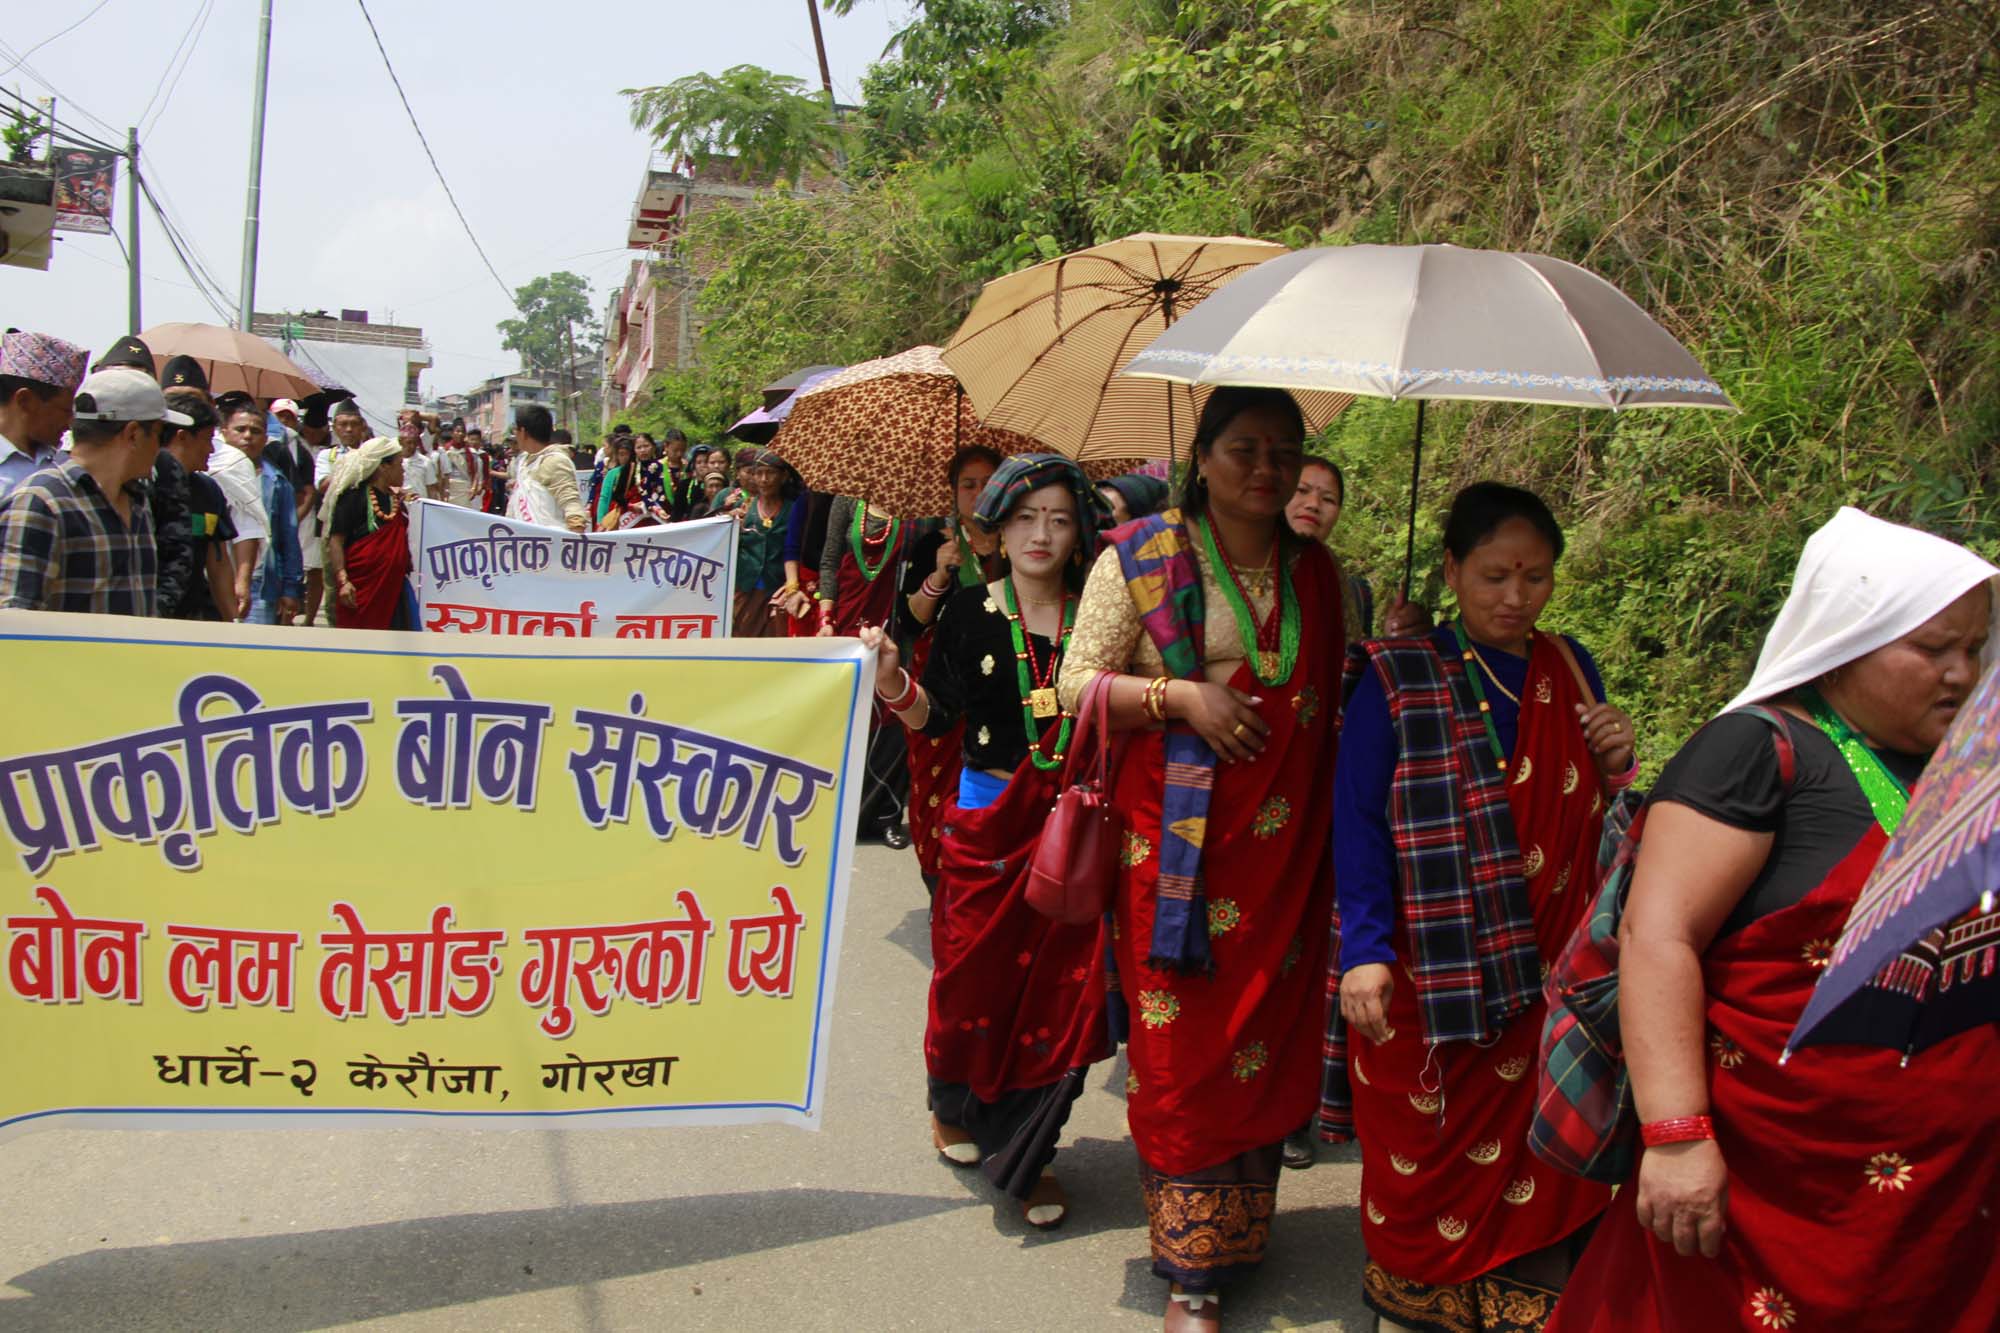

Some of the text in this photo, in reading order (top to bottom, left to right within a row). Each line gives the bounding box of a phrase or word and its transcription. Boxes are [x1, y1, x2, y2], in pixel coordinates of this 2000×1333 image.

[427, 523, 552, 589] प्राकृतिक
[624, 538, 725, 599] संस्कार
[0, 665, 834, 873] प्राकृतिक बोन संस्कार
[7, 886, 144, 1000] बोन
[168, 925, 298, 1007] लम
[541, 1053, 679, 1095] गोरखा
